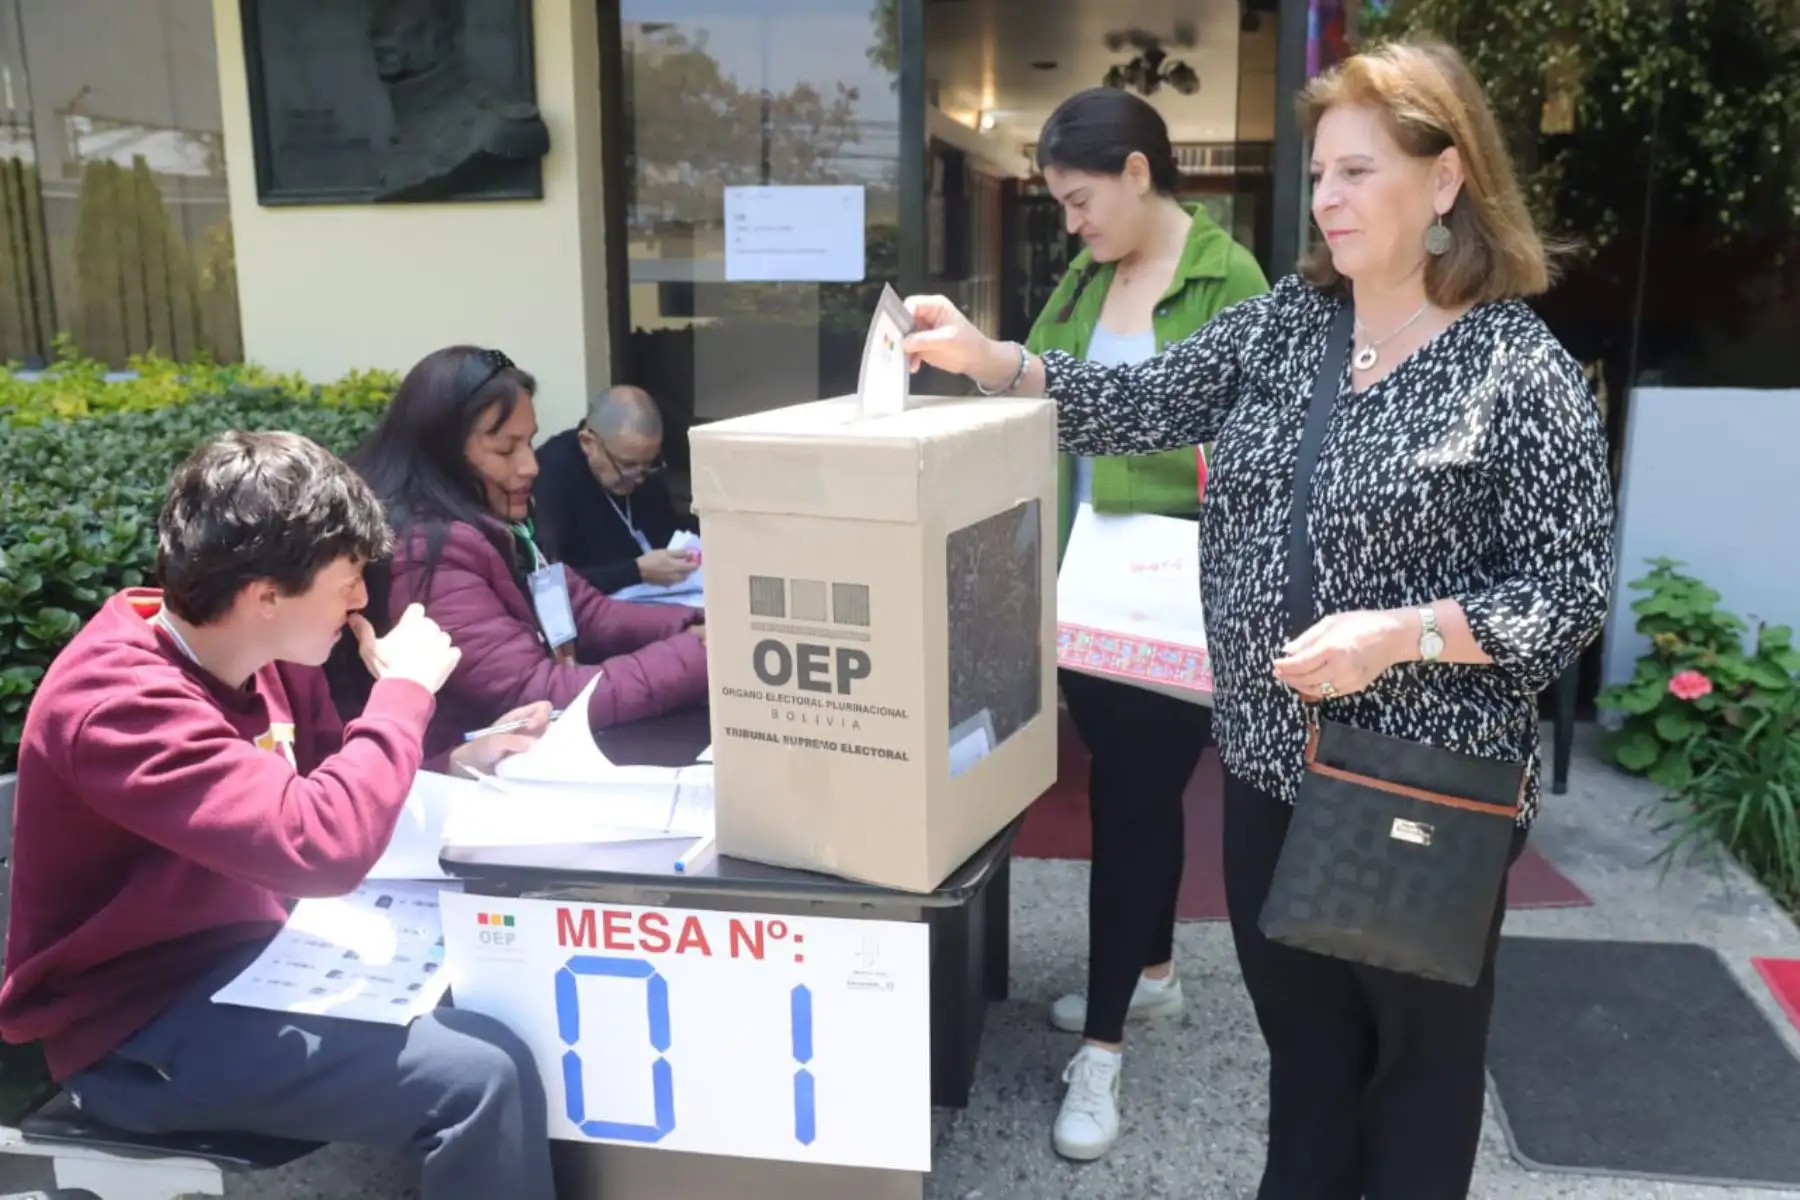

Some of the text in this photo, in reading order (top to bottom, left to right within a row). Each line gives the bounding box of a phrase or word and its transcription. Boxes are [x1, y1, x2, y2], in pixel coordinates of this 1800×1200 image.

[753, 639, 872, 695] OEP
[765, 692, 825, 709] ELECTORAL
[826, 700, 909, 719] PLURINACIONAL
[724, 727, 910, 762] TRIBUNAL SUPREMO ELECTORAL
[479, 930, 516, 946] OEP
[556, 907, 712, 957] MESA
